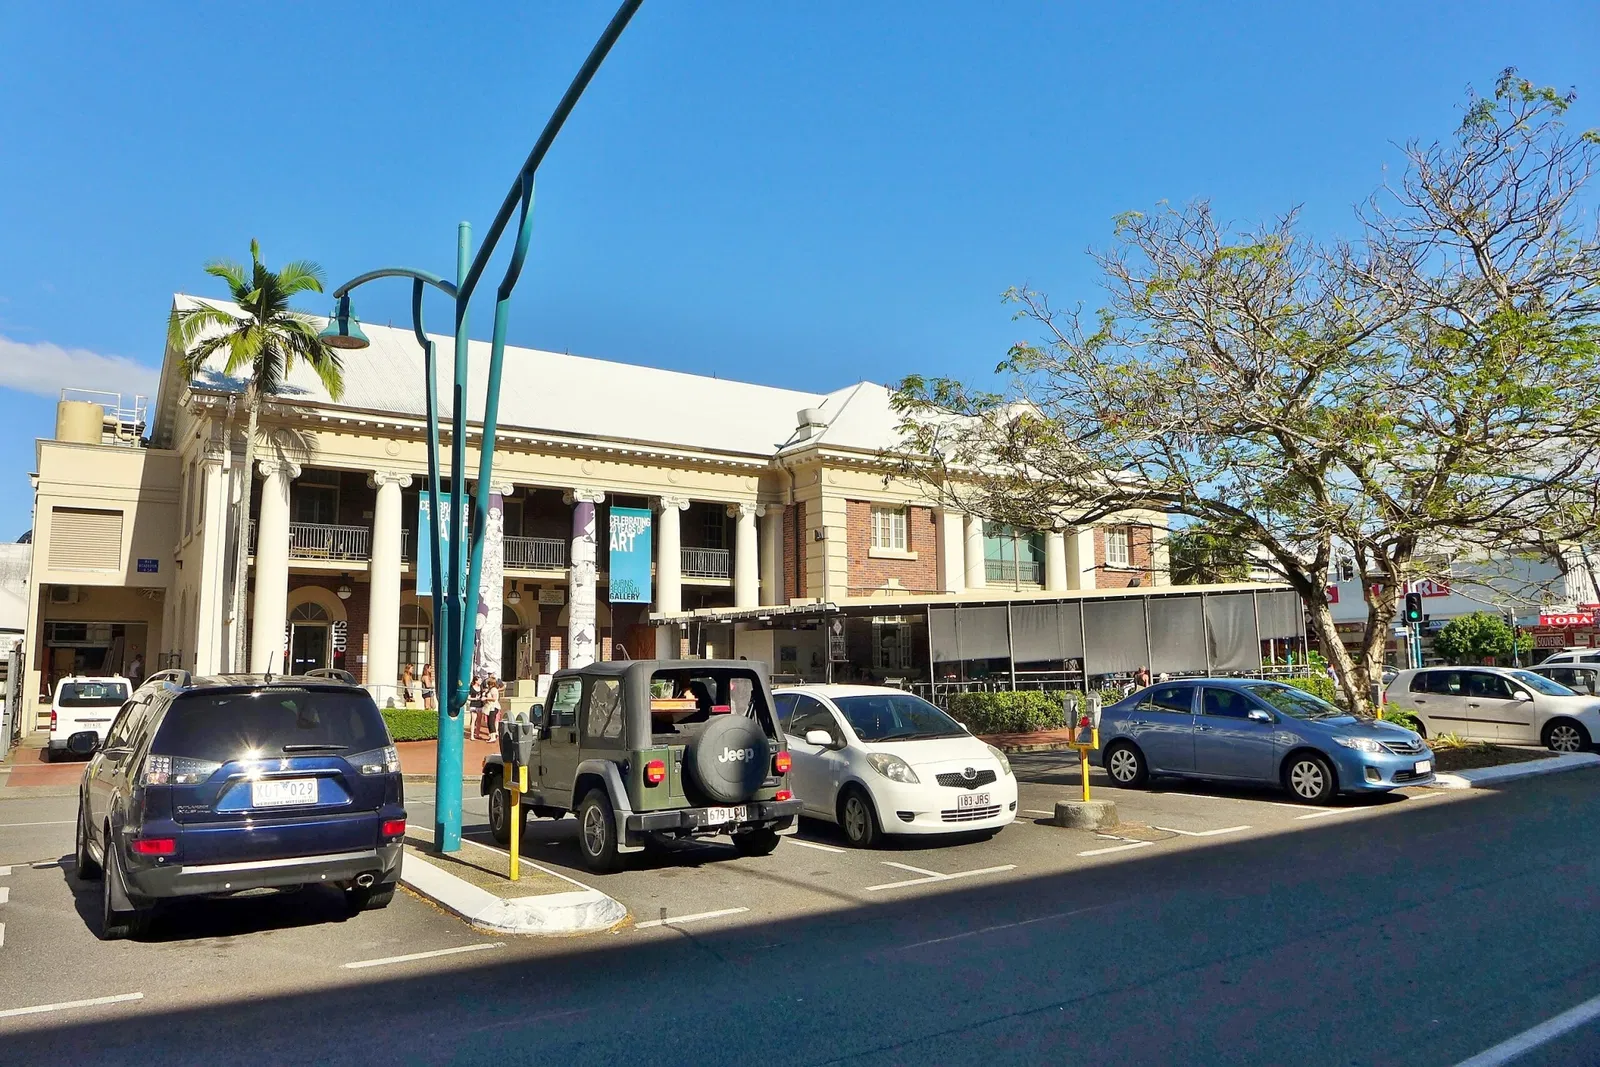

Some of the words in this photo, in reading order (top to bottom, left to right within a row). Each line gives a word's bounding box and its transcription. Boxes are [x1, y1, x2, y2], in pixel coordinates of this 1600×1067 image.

[610, 515, 651, 527] CELEBRATING
[617, 523, 636, 535] YEARS
[637, 525, 645, 535] OF
[610, 532, 635, 552] ART
[610, 592, 640, 601] GALLERY
[333, 620, 348, 653] SHOP
[717, 746, 755, 763] Jeep
[290, 782, 314, 796] 029
